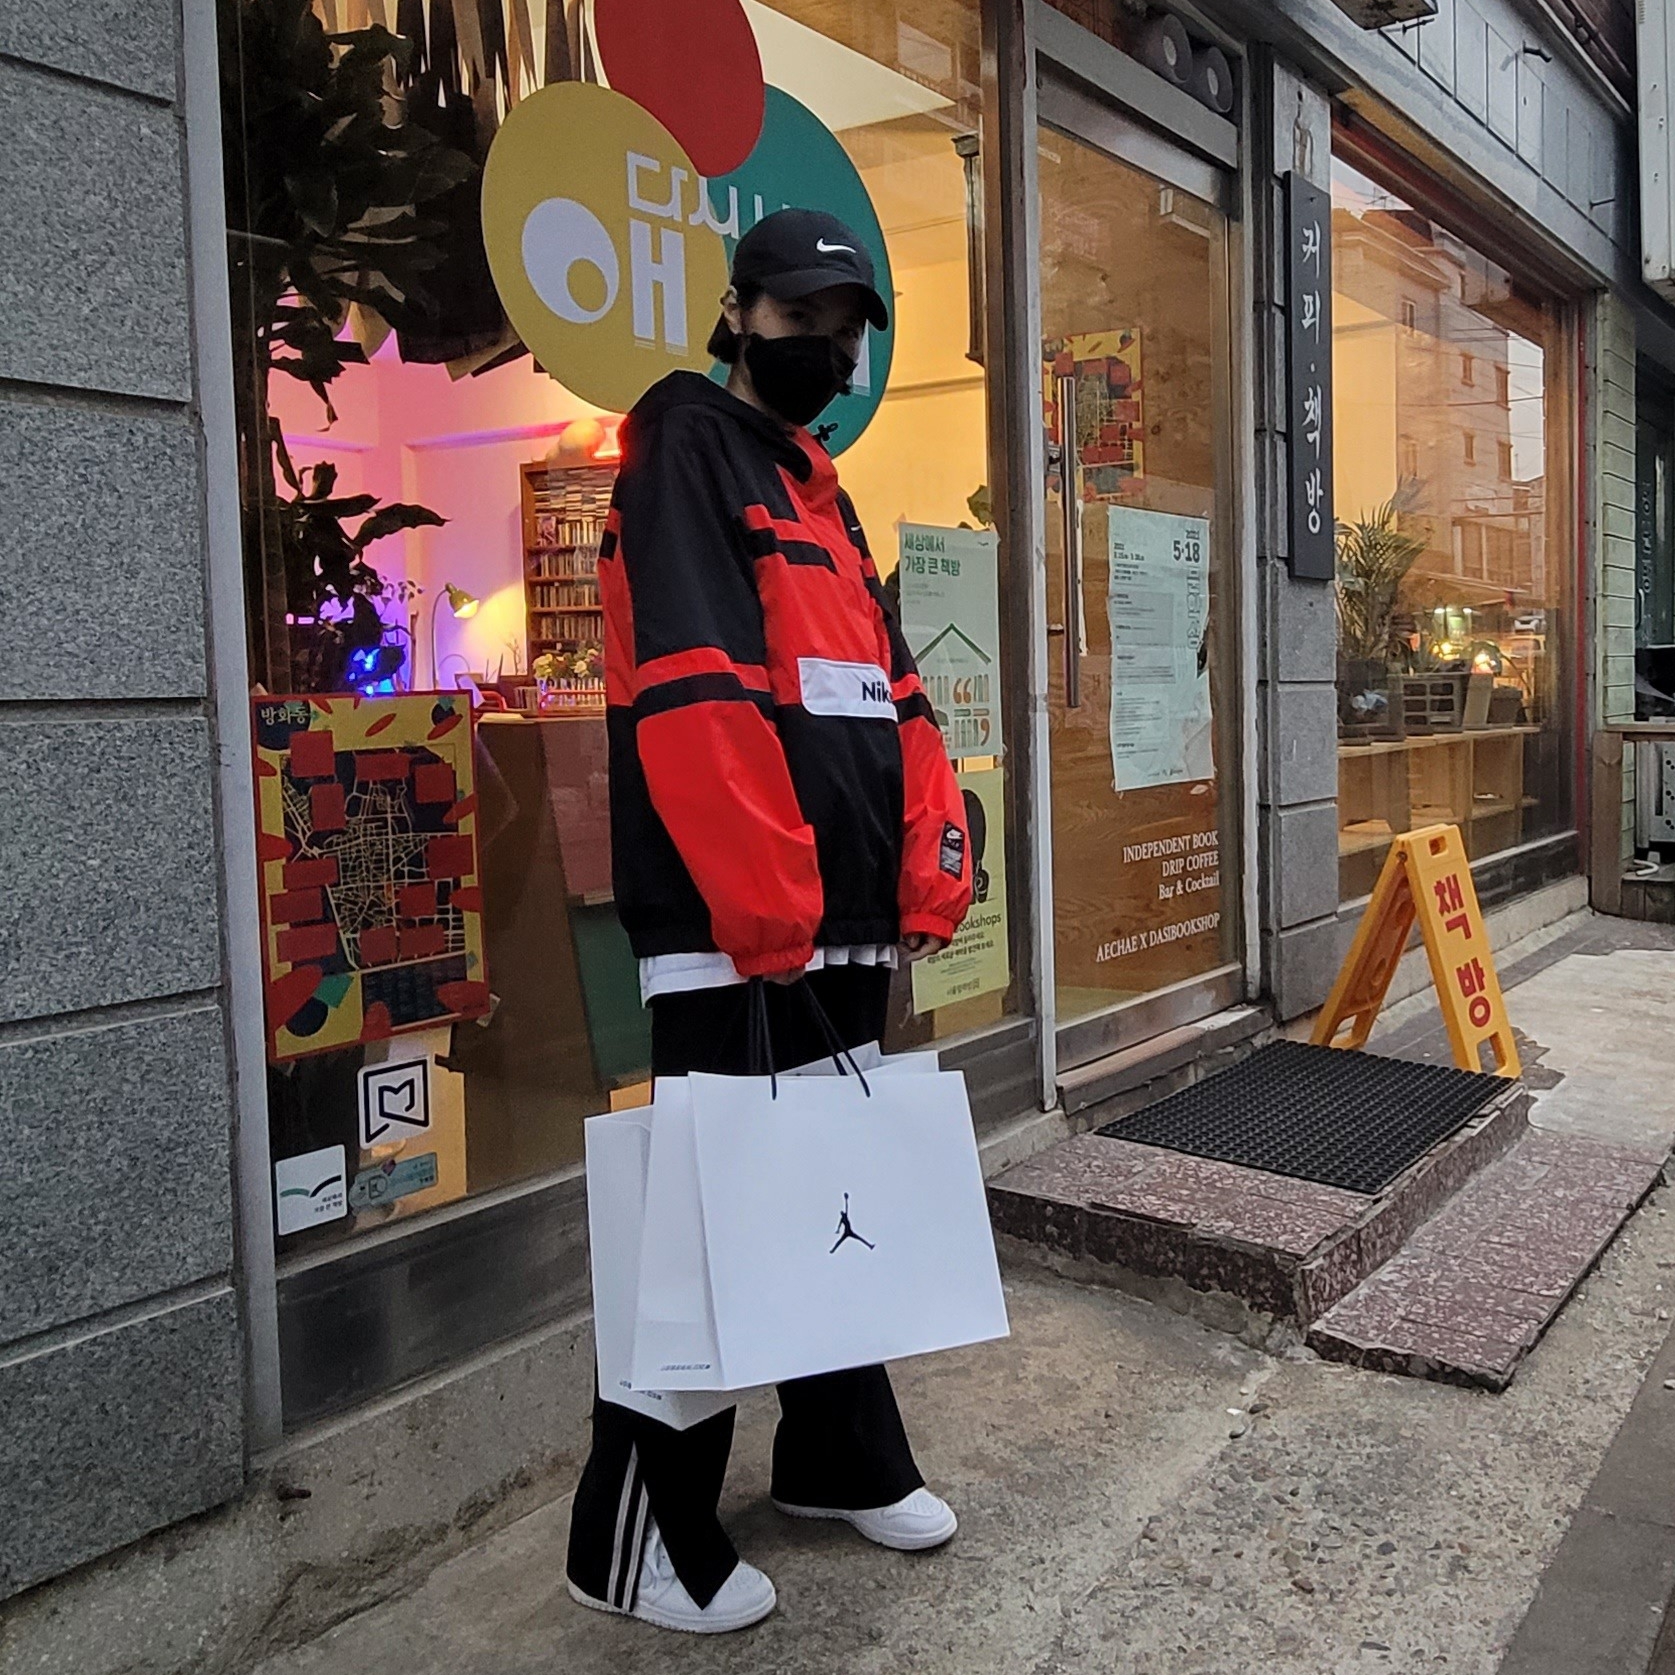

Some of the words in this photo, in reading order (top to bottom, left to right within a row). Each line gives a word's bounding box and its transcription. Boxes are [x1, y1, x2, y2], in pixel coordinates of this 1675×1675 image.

[905, 533, 945, 553] 세상에서
[905, 555, 925, 574] 가장
[928, 557, 938, 575] 큰
[941, 557, 961, 577] 책방
[261, 706, 309, 725] 방화동
[1123, 835, 1191, 863] INDEPENDENT
[1192, 830, 1219, 849] BOOK
[1162, 858, 1184, 877] DRIP
[1186, 850, 1219, 871] COFFEE
[1158, 883, 1174, 900] Bar
[1176, 880, 1184, 895] &
[1186, 870, 1220, 892] Cocktail
[958, 913, 1002, 933] ookshops
[1096, 936, 1138, 962] AECHAE
[1140, 932, 1148, 950] X
[1149, 912, 1220, 947] DASIBOOKSHOP
[1434, 873, 1491, 1028] 책방
